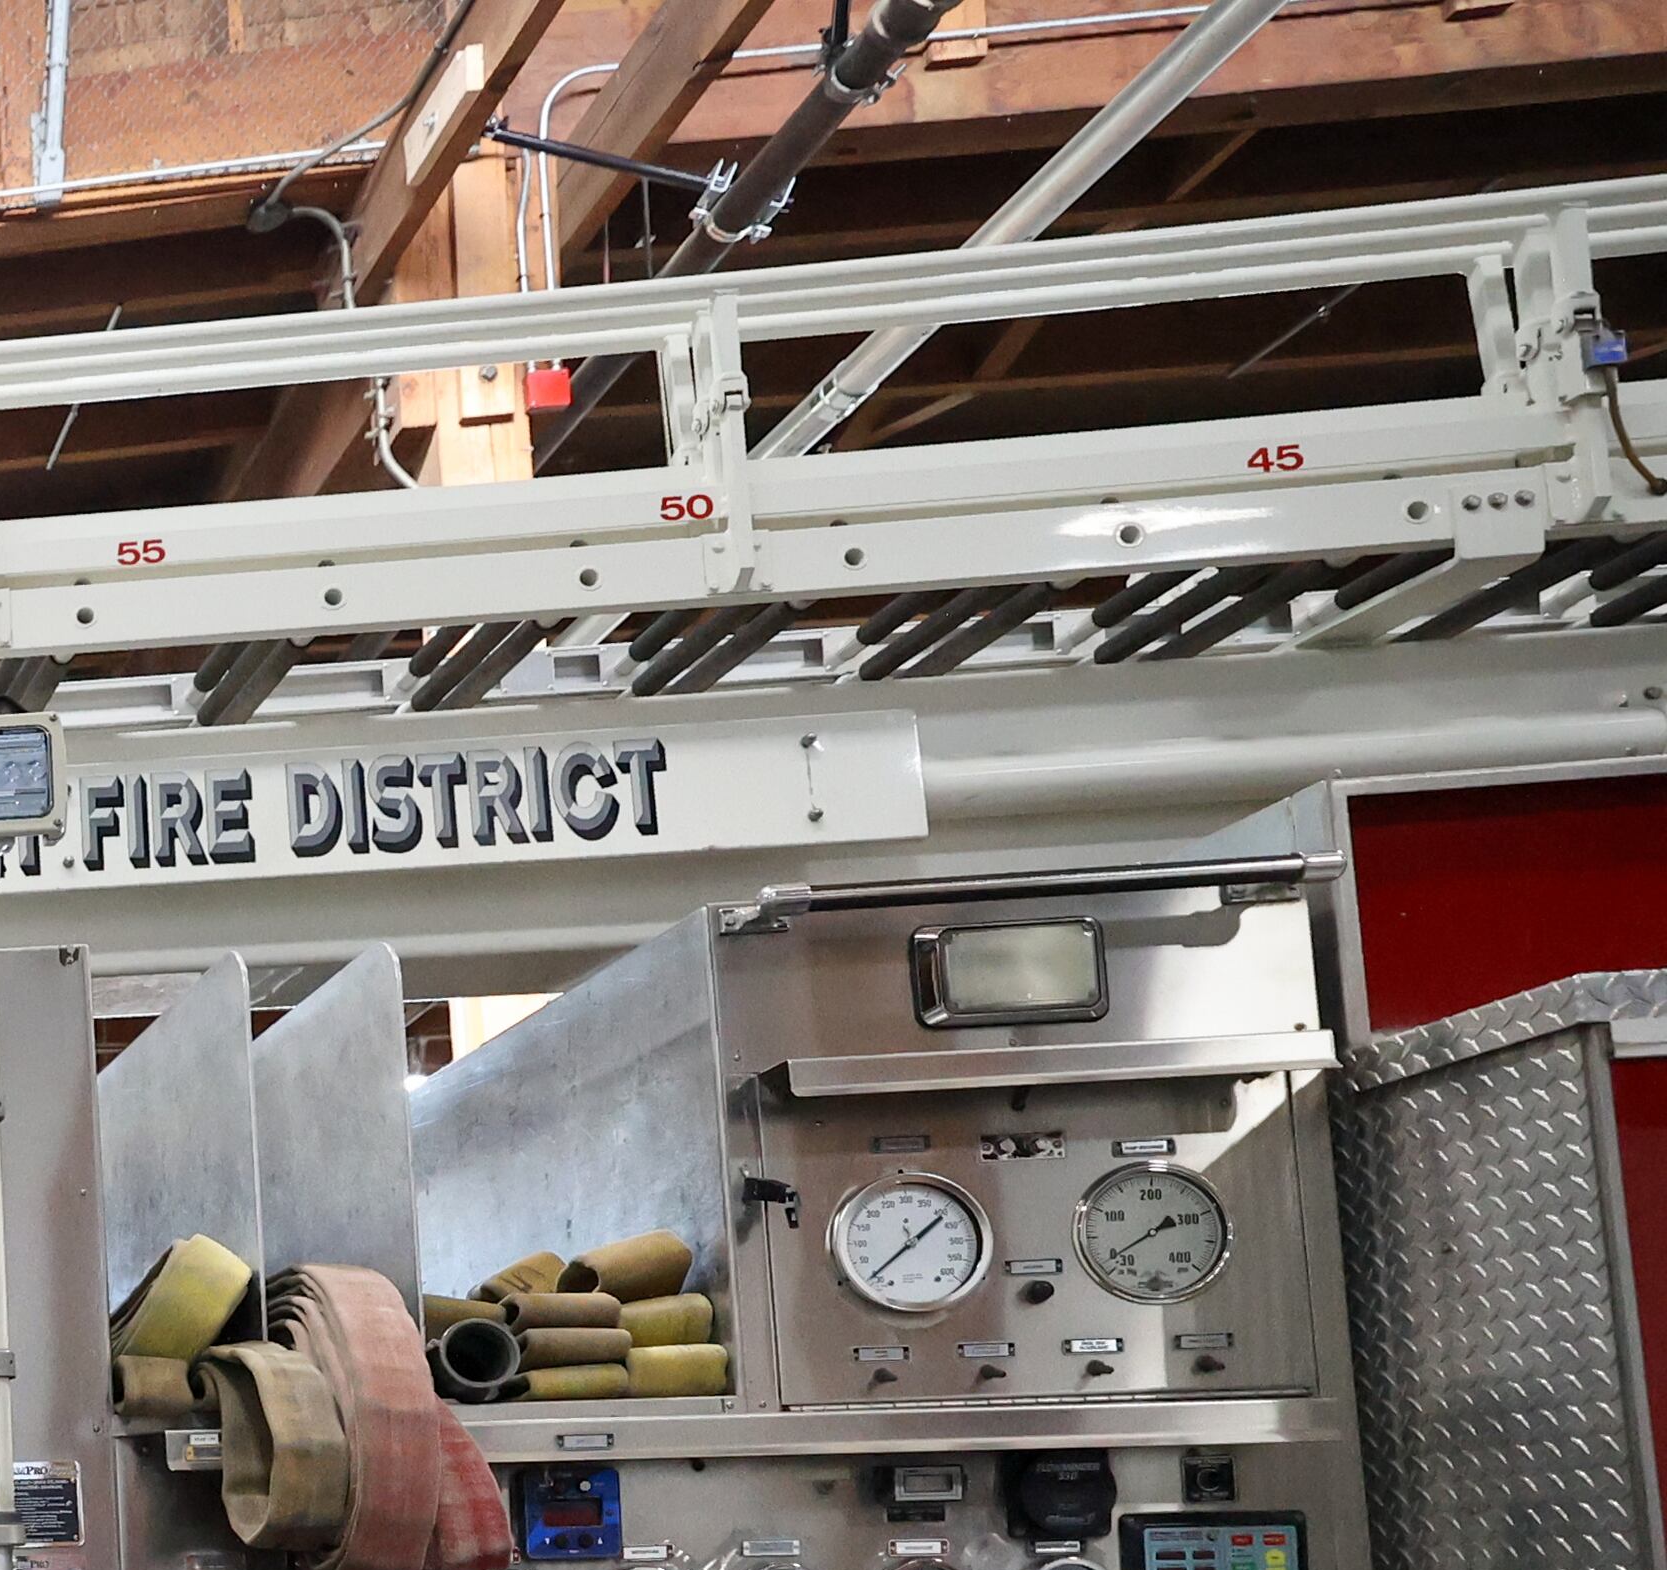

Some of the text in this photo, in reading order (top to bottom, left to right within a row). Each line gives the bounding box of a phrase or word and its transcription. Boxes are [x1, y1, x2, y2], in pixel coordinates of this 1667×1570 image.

[1249, 445, 1304, 471] 45
[662, 494, 713, 520] 50
[119, 540, 166, 565] 55
[79, 767, 256, 871] FIRE
[284, 738, 667, 858] DISTRICT
[1140, 1188, 1162, 1201] 200
[1104, 1210, 1125, 1222] 100
[1177, 1213, 1200, 1225] 300
[1168, 1251, 1191, 1264] 400
